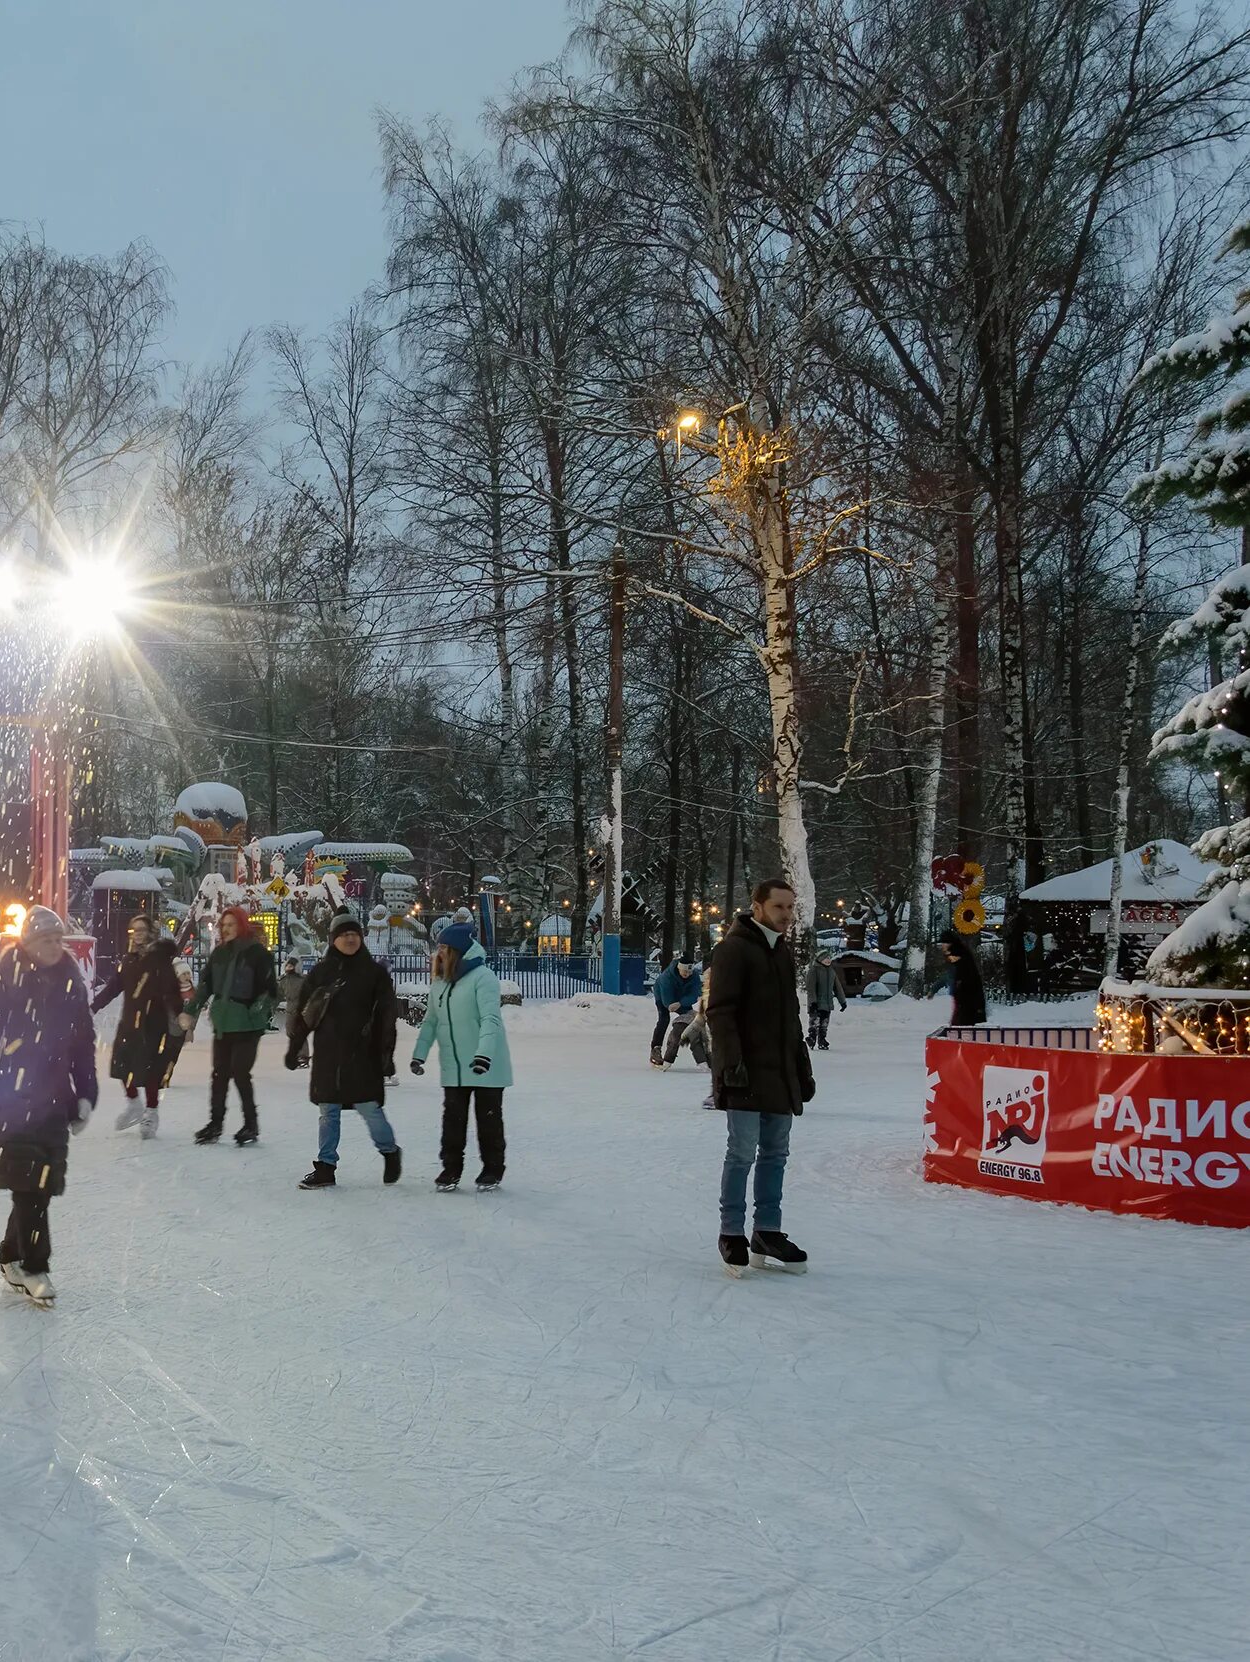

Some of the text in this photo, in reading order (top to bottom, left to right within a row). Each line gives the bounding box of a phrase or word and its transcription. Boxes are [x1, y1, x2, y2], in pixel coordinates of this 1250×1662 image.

[1121, 908, 1180, 922] АССА
[986, 1086, 1030, 1108] РАДИО
[986, 1075, 1045, 1151] NRJ
[979, 1161, 1041, 1182] ENERGY 96.8
